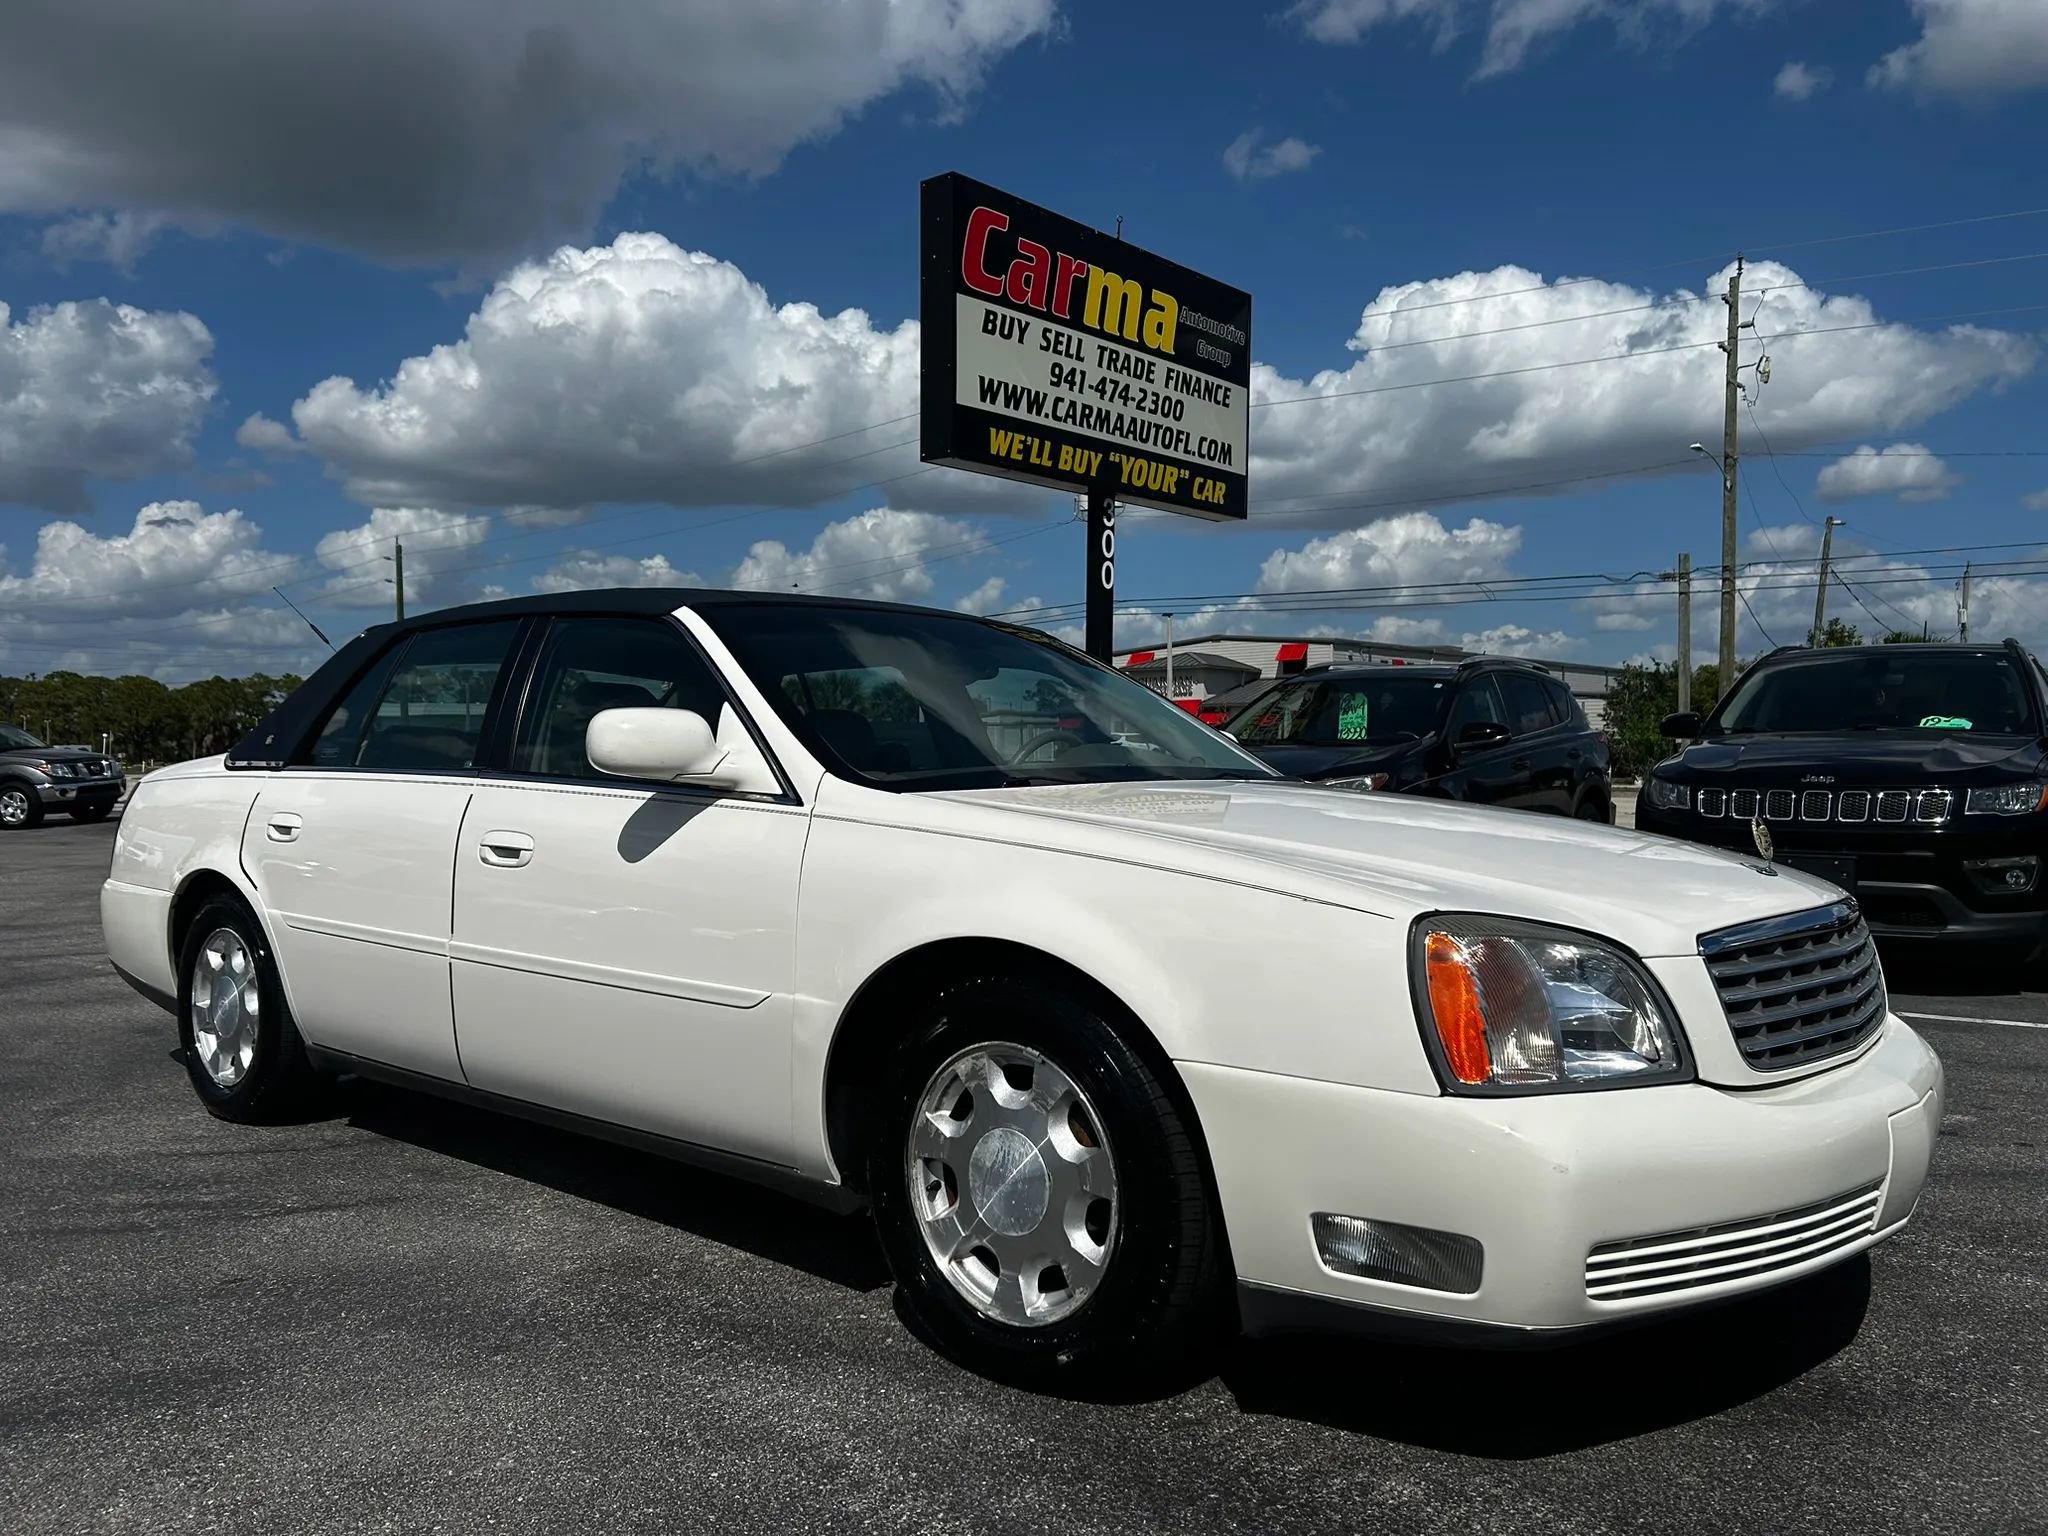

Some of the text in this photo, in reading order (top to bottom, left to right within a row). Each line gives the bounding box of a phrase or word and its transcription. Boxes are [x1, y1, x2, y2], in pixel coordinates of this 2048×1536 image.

[962, 206, 1178, 354] Carma
[981, 308, 1232, 409] BUY SELL TRADE FINANCE
[1179, 305, 1246, 346] Automotive
[1196, 339, 1232, 368] Group
[978, 374, 1233, 467] WWW.CARMAAUTOFL.COM
[1049, 362, 1185, 422] 941-474-2300
[989, 427, 1053, 468] WE'LL
[1058, 444, 1103, 477] BUY
[1192, 476, 1227, 505] CAR
[1101, 497, 1115, 590] 300
[1800, 773, 1835, 785] Jeep
